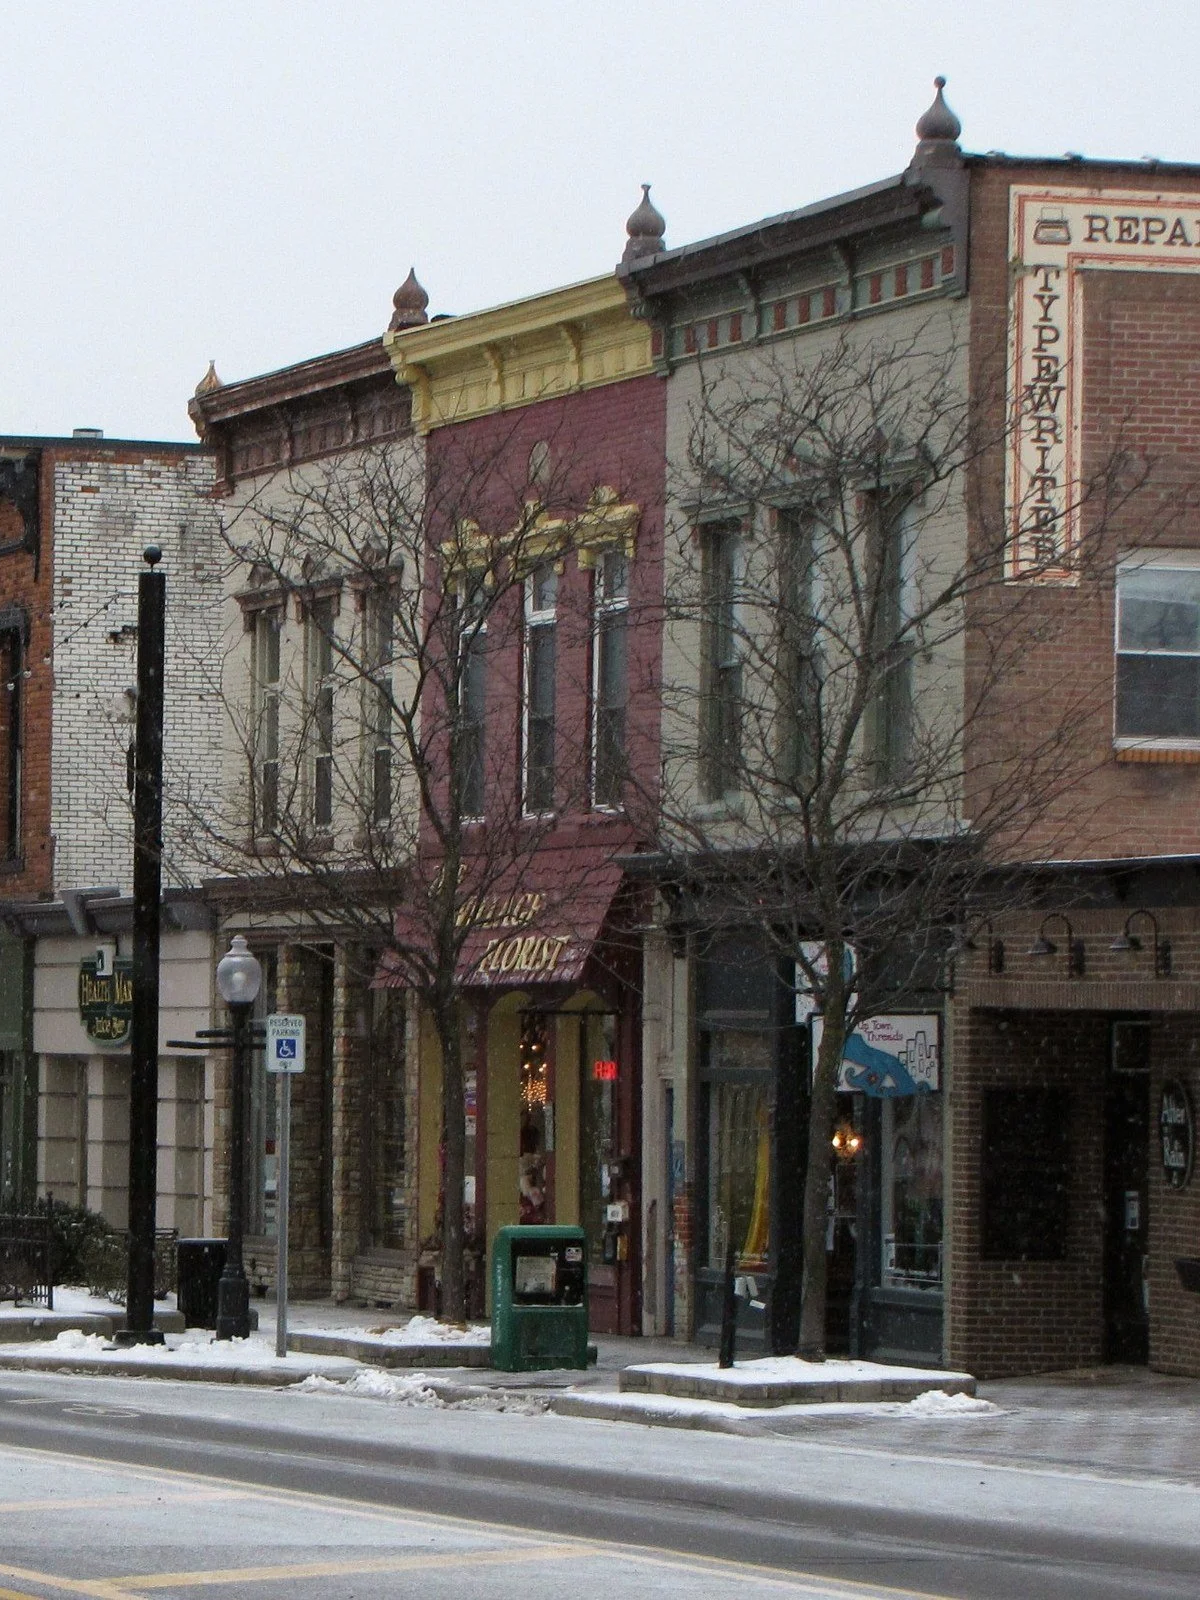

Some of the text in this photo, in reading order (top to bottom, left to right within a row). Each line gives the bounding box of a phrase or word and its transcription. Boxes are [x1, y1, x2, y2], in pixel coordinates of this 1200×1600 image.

[1022, 264, 1067, 569] TYPEWRITER
[478, 935, 571, 973] FLORIST
[269, 1019, 303, 1027] RESERVED
[271, 1028, 300, 1036] PARKING
